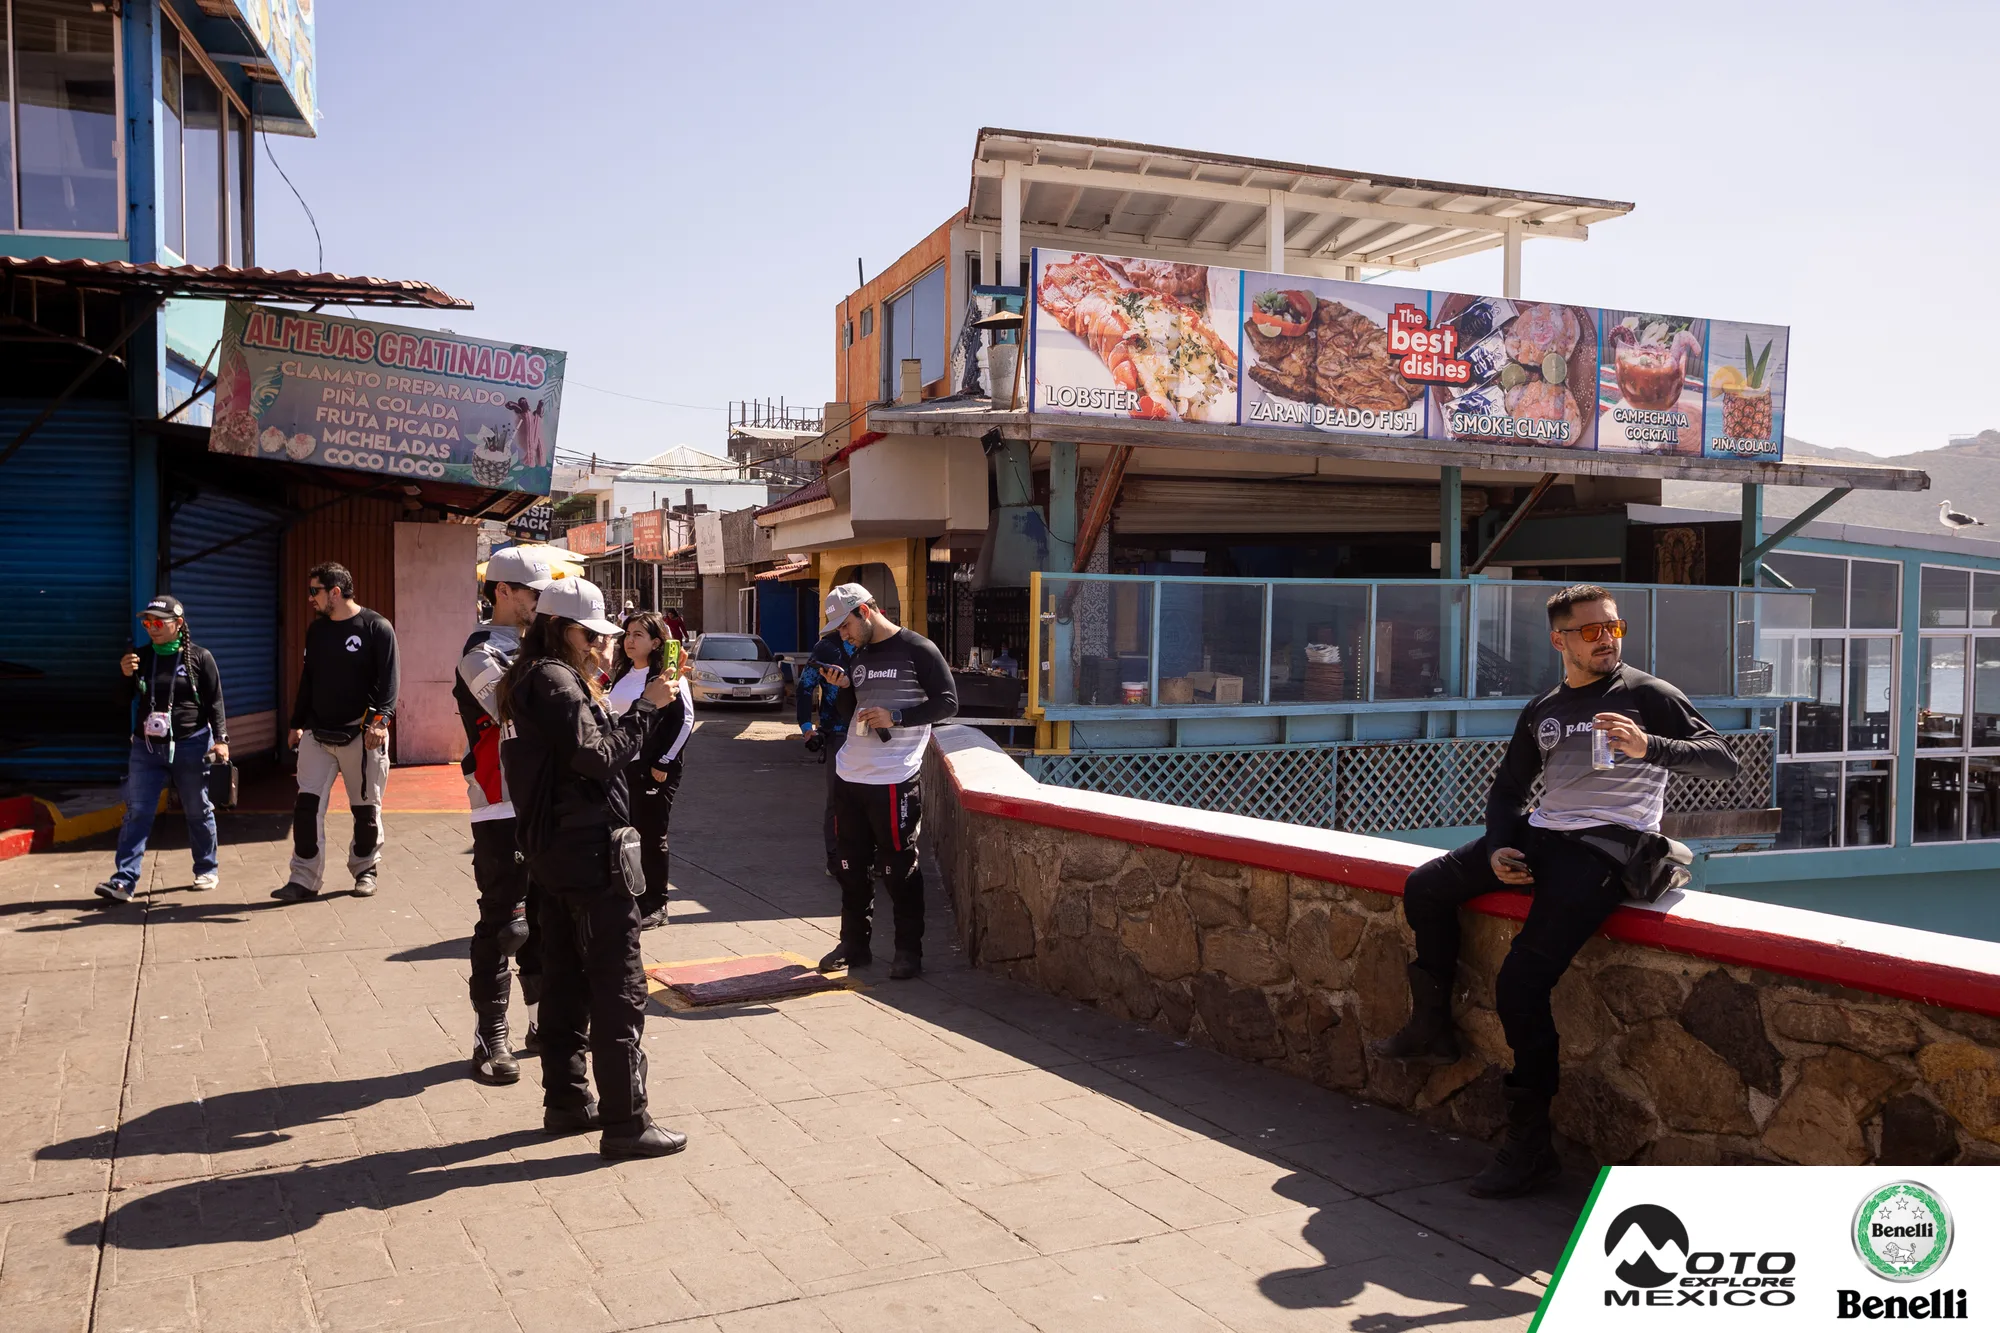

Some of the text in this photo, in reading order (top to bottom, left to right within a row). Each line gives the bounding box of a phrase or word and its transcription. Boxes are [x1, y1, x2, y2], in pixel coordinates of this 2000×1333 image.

[1399, 309, 1423, 324] The
[1391, 319, 1454, 354] best
[243, 312, 547, 388] ALMEJAS GRATINADAS
[1403, 353, 1467, 379] dishes
[281, 361, 506, 406] CLAMATO PREPARADO
[322, 387, 460, 421] PIÑA COLADA
[1045, 385, 1142, 411] LOBSTER
[316, 406, 460, 441] FRUTA PICADA
[1379, 411, 1417, 431] FISH
[1454, 414, 1569, 440] SMOKE CLAMS
[1613, 409, 1688, 427] CAMPECHANA
[322, 427, 451, 459] MICHELADAS
[1625, 427, 1679, 443] COCKTAIL
[1712, 436, 1778, 454] PIÑA COLADA
[323, 448, 445, 478] COCO LOCO
[511, 517, 549, 531] BACK
[867, 668, 898, 679] Benelli
